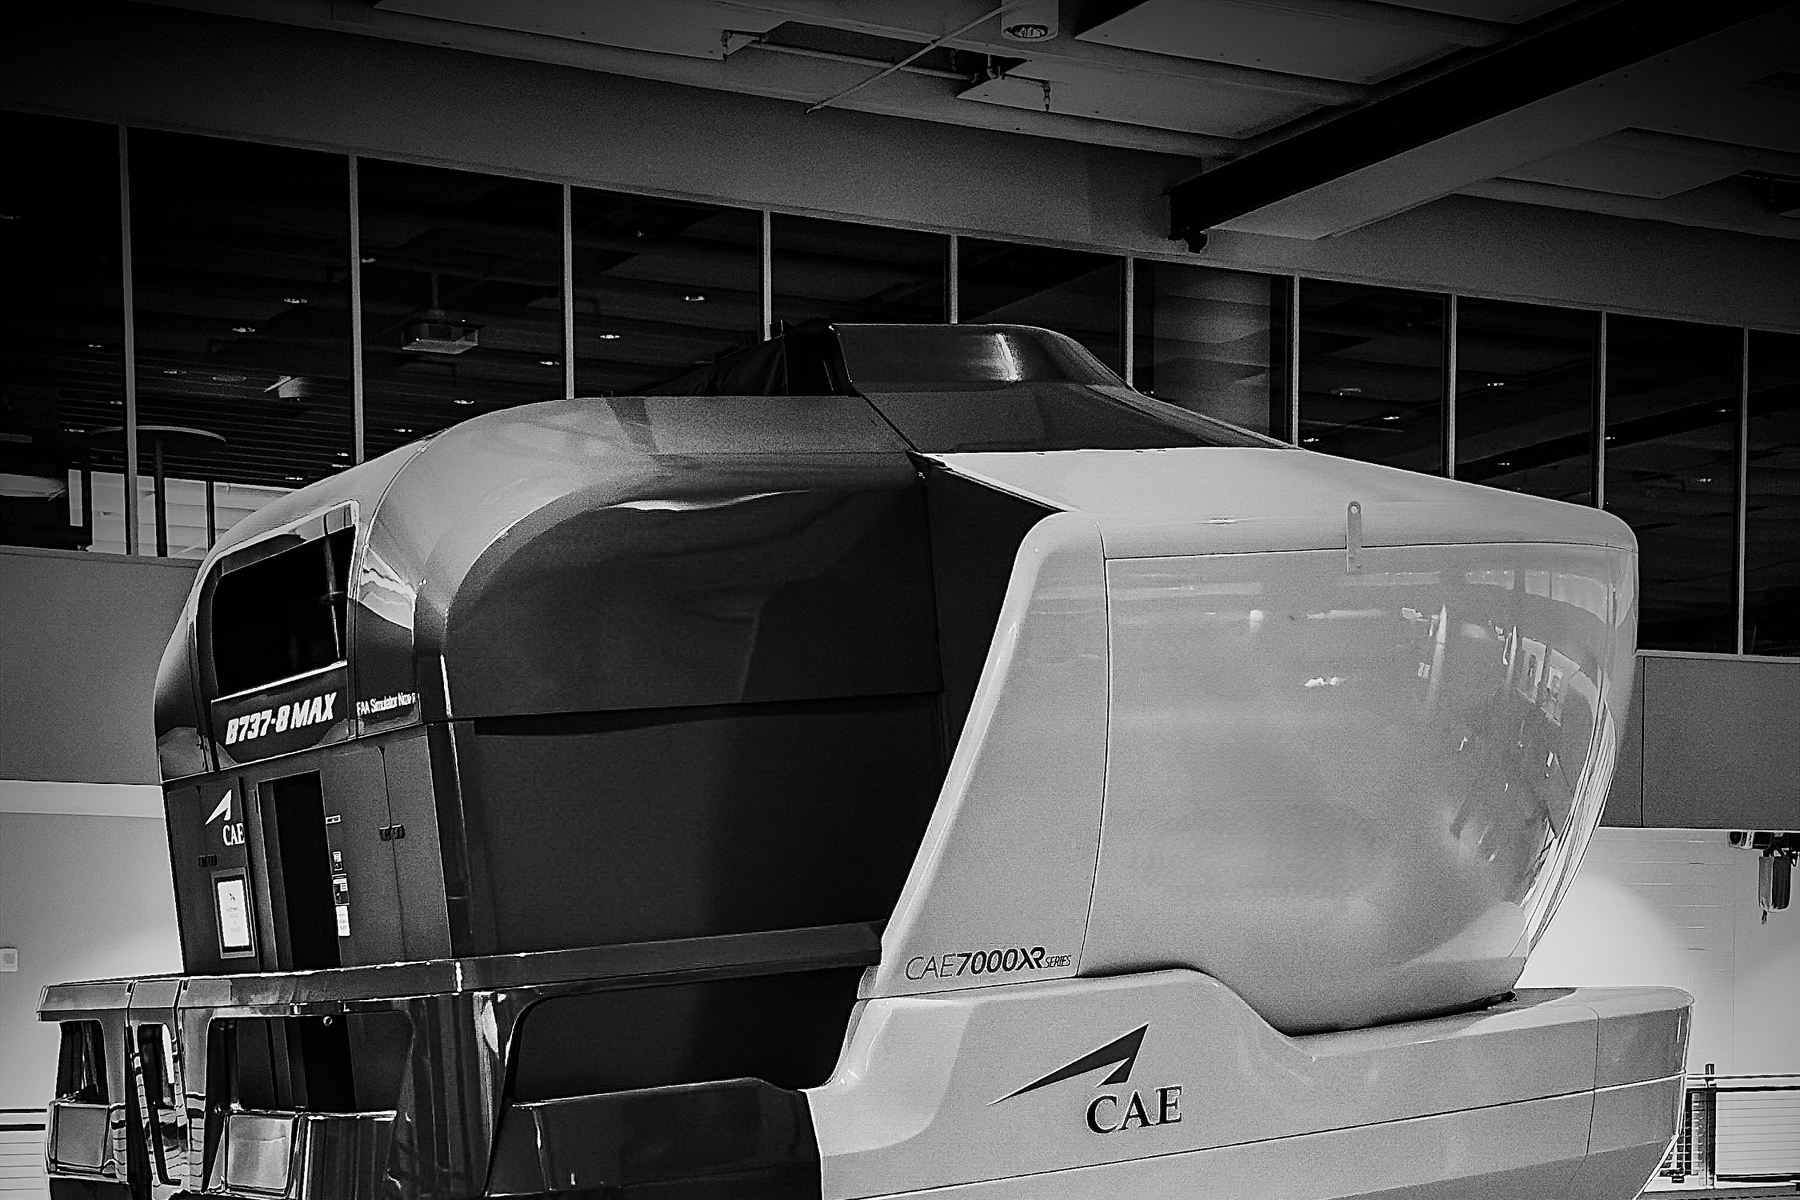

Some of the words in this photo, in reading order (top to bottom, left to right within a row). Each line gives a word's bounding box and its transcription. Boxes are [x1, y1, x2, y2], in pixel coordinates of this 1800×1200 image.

[225, 704, 291, 745] B737-8
[290, 691, 337, 730] MAX
[222, 821, 246, 846] CAE
[1086, 1084, 1183, 1134] CAE
